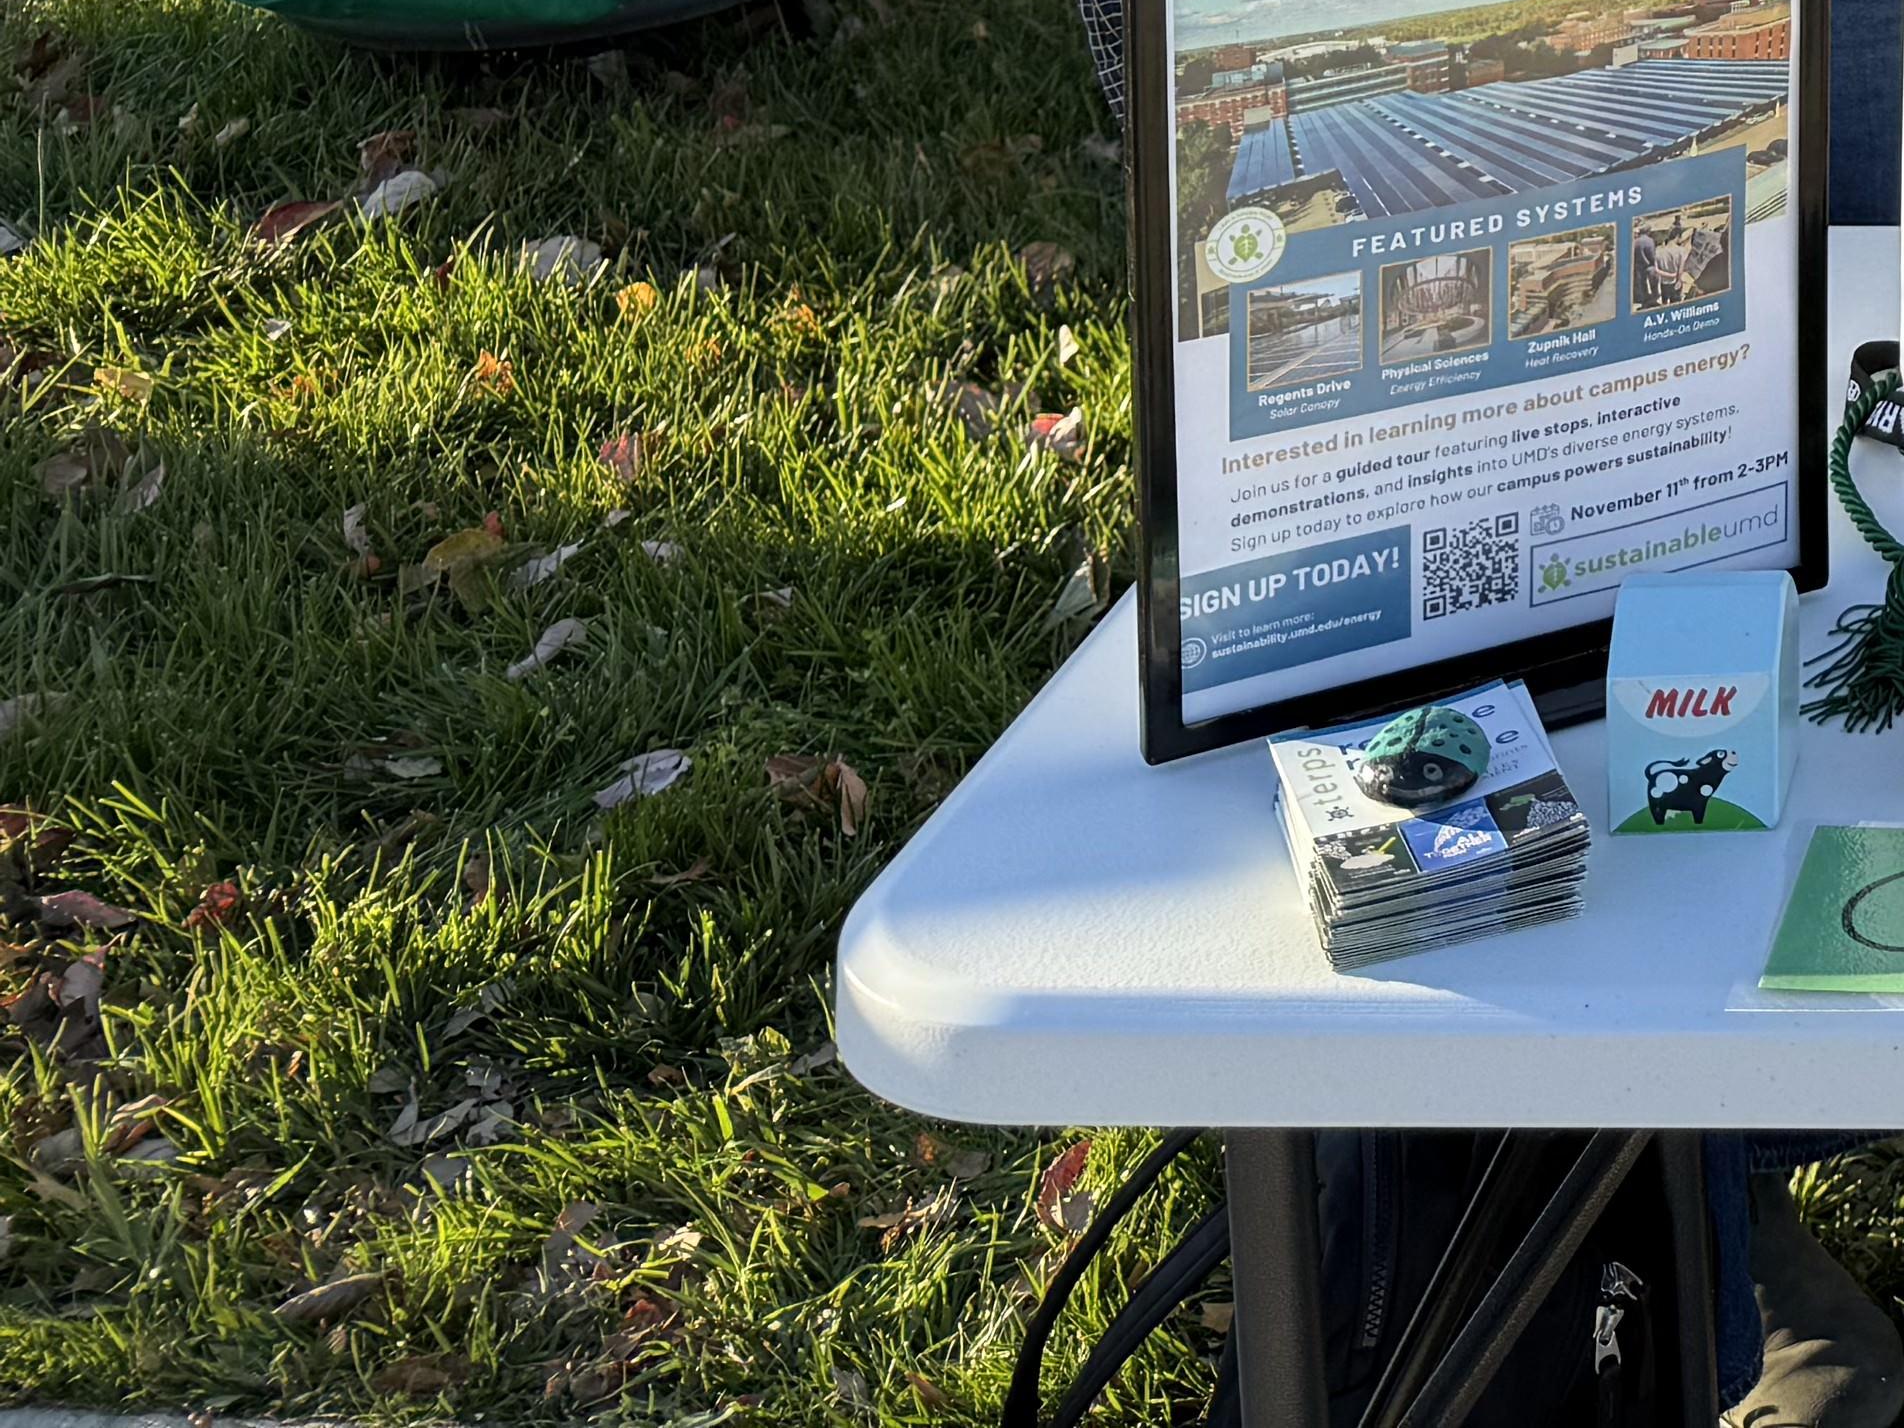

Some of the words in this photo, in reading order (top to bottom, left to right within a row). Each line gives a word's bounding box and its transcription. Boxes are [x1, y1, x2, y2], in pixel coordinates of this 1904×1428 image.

[1352, 214, 1503, 257] FEATURED
[1517, 186, 1642, 227] SYSTEMS
[1644, 315, 1668, 329] A.V.
[1671, 301, 1719, 322] Williams
[1382, 361, 1431, 380] Physical
[1435, 352, 1489, 370] Sciences
[1528, 337, 1570, 355] Zupnik
[1573, 329, 1596, 344] Hall
[1552, 346, 1599, 364] Recovery
[1222, 435, 1338, 474] Interested
[1344, 431, 1363, 448] in
[1370, 413, 1457, 444] learning
[1462, 400, 1517, 424] more
[1524, 386, 1584, 412] about
[1589, 366, 1667, 399] campus
[1673, 344, 1750, 377] energy?
[1259, 388, 1313, 406] Regents
[1317, 379, 1351, 395] Drive
[1270, 407, 1297, 419] Solar
[1300, 399, 1341, 414] Canopy
[1231, 486, 1267, 504] Join
[1271, 481, 1290, 493] us
[1294, 473, 1317, 489] for
[1322, 471, 1332, 482] a
[1336, 456, 1392, 482] guided
[1397, 451, 1430, 466] tour
[1435, 434, 1508, 459] featuring
[1512, 426, 1540, 443] live
[1598, 396, 1680, 425] interactive
[1374, 480, 1403, 496] and
[1408, 464, 1472, 489] insights
[1477, 457, 1508, 473] into
[1512, 448, 1559, 468] UMD's
[1562, 435, 1618, 457] diverse
[1623, 422, 1672, 445] energy
[1231, 535, 1267, 553] Sign
[1271, 529, 1292, 545] up
[1296, 516, 1341, 538] today
[1347, 513, 1362, 526] to
[1367, 499, 1425, 523] explore
[1430, 492, 1463, 508] how
[1467, 483, 1493, 499] our
[1497, 471, 1561, 493] campus
[1564, 456, 1623, 482] powers
[1627, 426, 1731, 465] sustainability!
[1571, 487, 1662, 521] November
[1693, 470, 1734, 490] from
[1738, 451, 1789, 479] 2-3PM
[1180, 584, 1240, 621] SIGN
[1250, 573, 1286, 602] UP
[1293, 547, 1400, 590] TODAY!
[1211, 631, 1235, 645] Visit
[1238, 628, 1250, 637] to
[1253, 620, 1281, 634] learn
[1283, 612, 1315, 628] more:
[1212, 609, 1382, 659] sustainability.umd.edu/energy
[1645, 686, 1737, 718] MILK
[1297, 746, 1337, 809] terps
